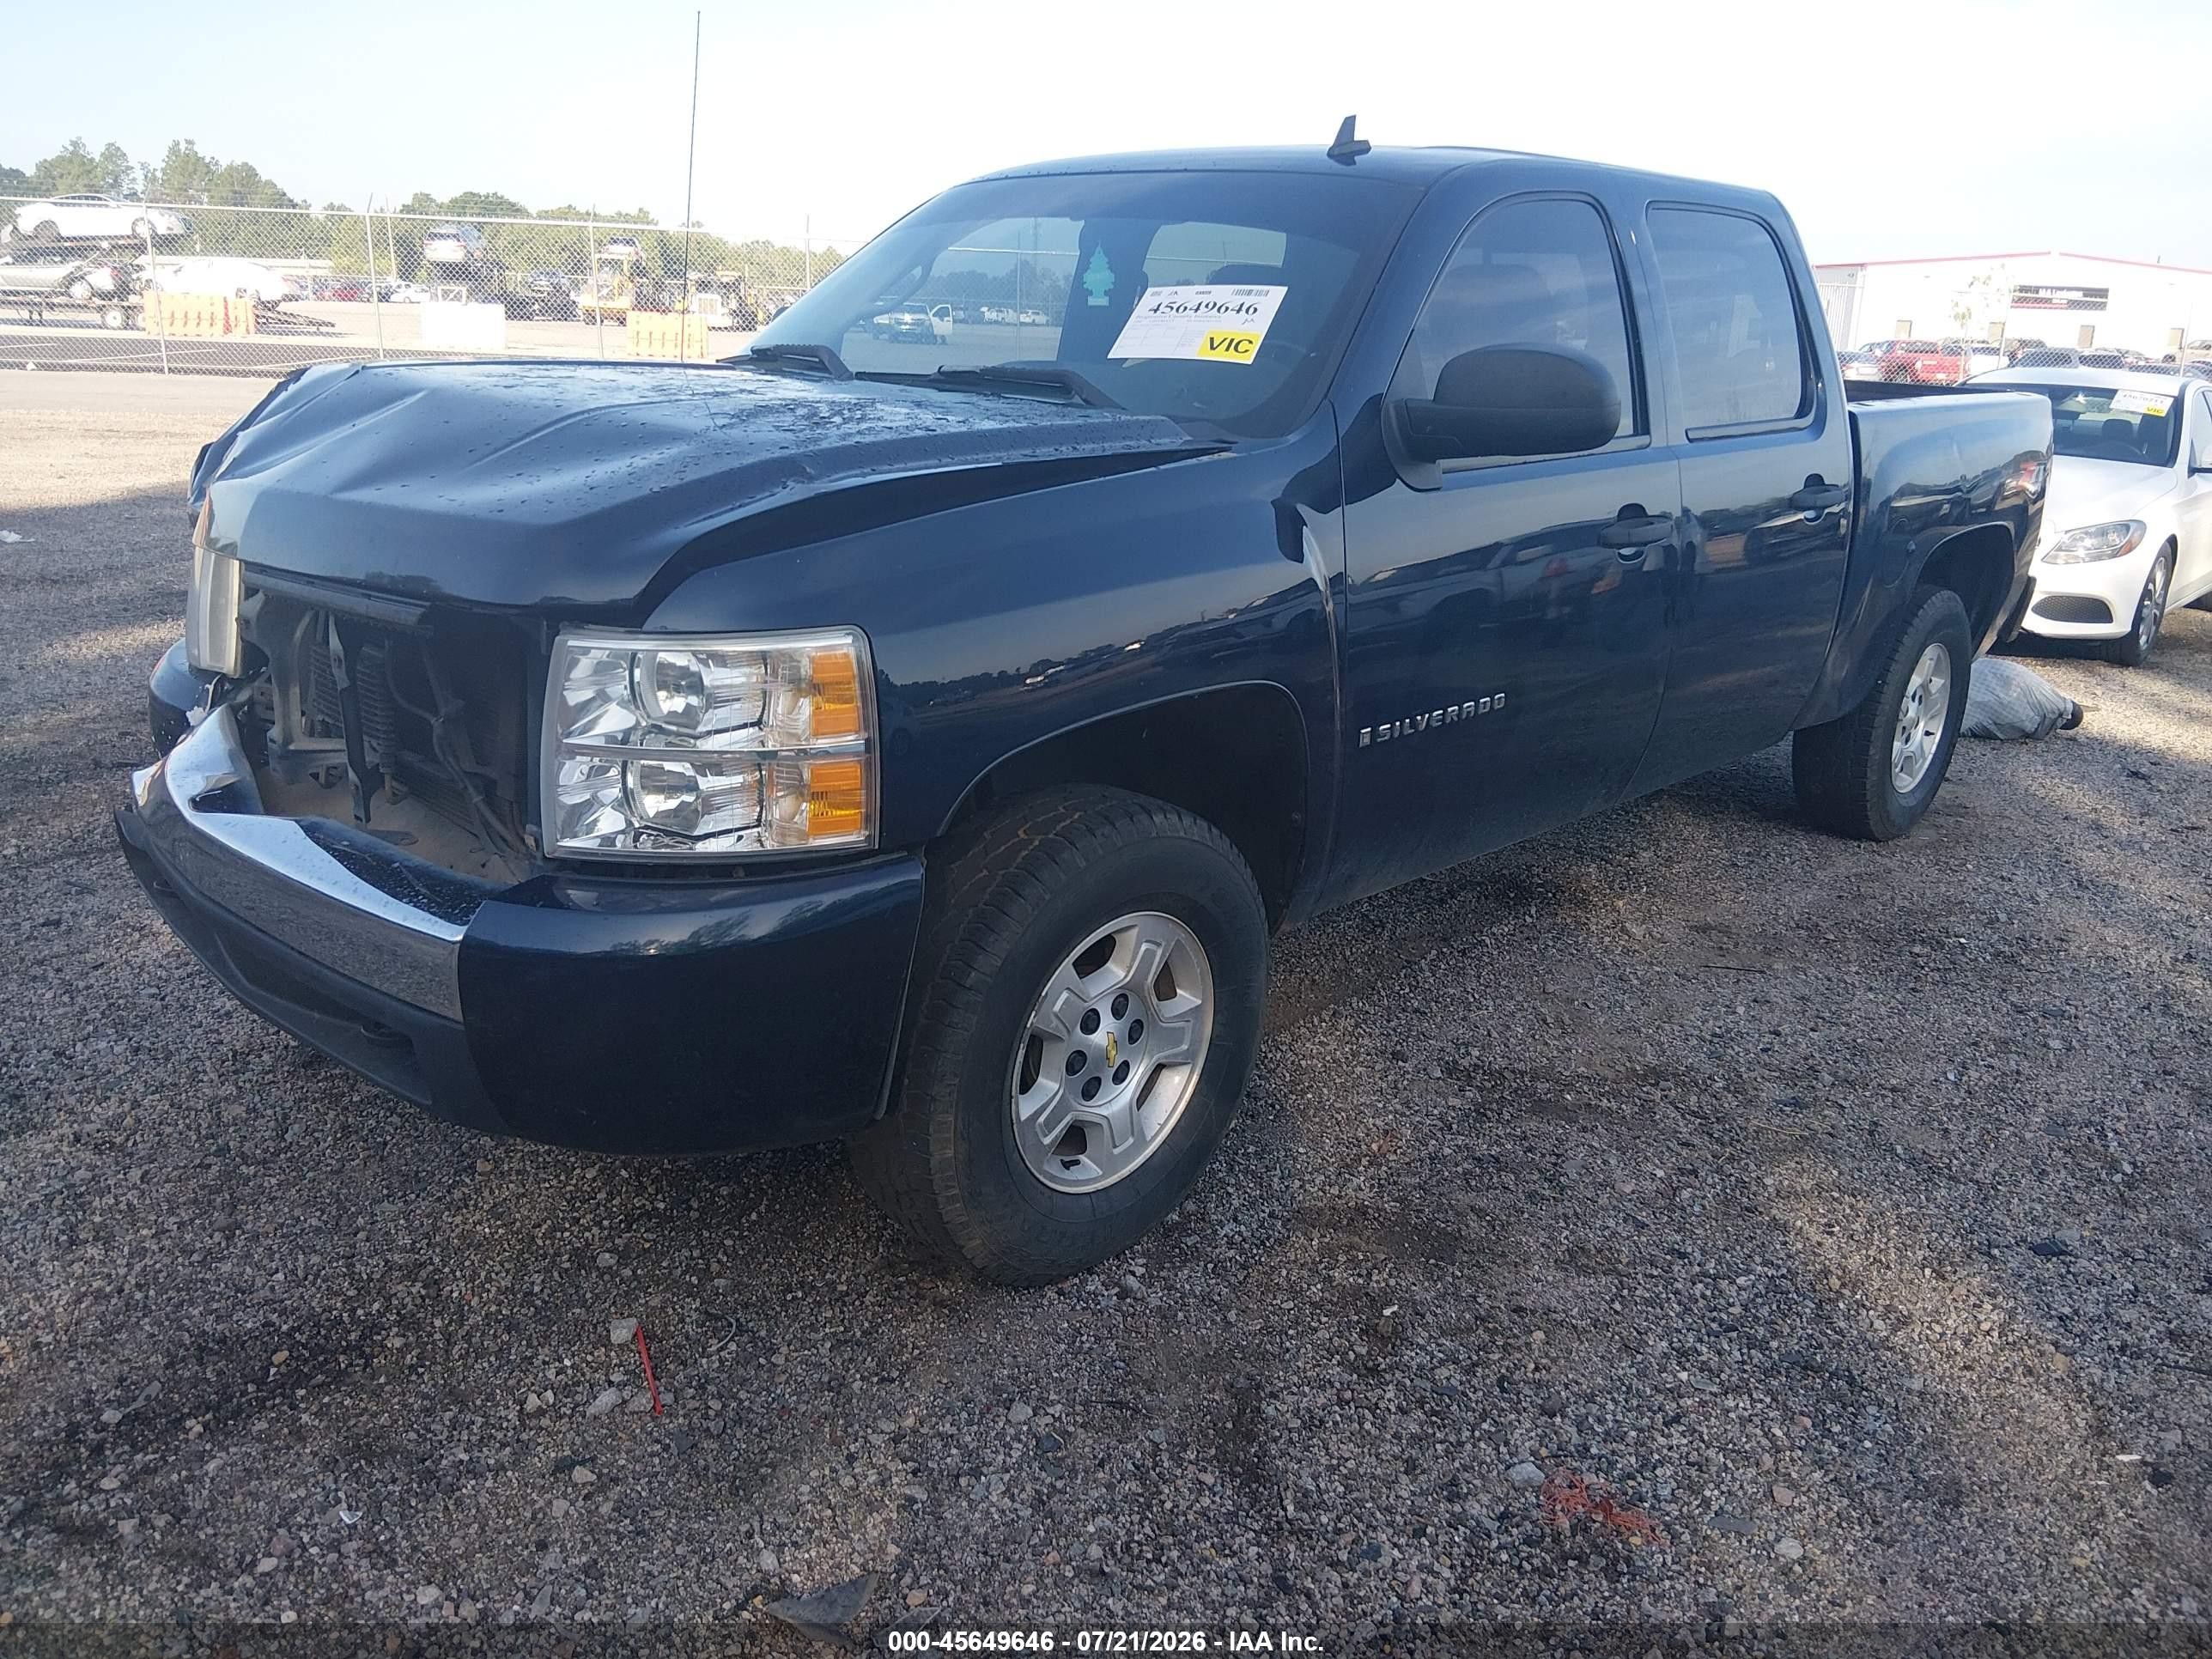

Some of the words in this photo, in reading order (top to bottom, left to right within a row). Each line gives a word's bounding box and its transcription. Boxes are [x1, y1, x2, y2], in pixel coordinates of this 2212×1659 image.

[1148, 300, 1261, 316] 45649646
[1208, 337, 1254, 354] VIC
[2146, 406, 2165, 415] VIC
[1376, 692, 1505, 743] SILVERADO
